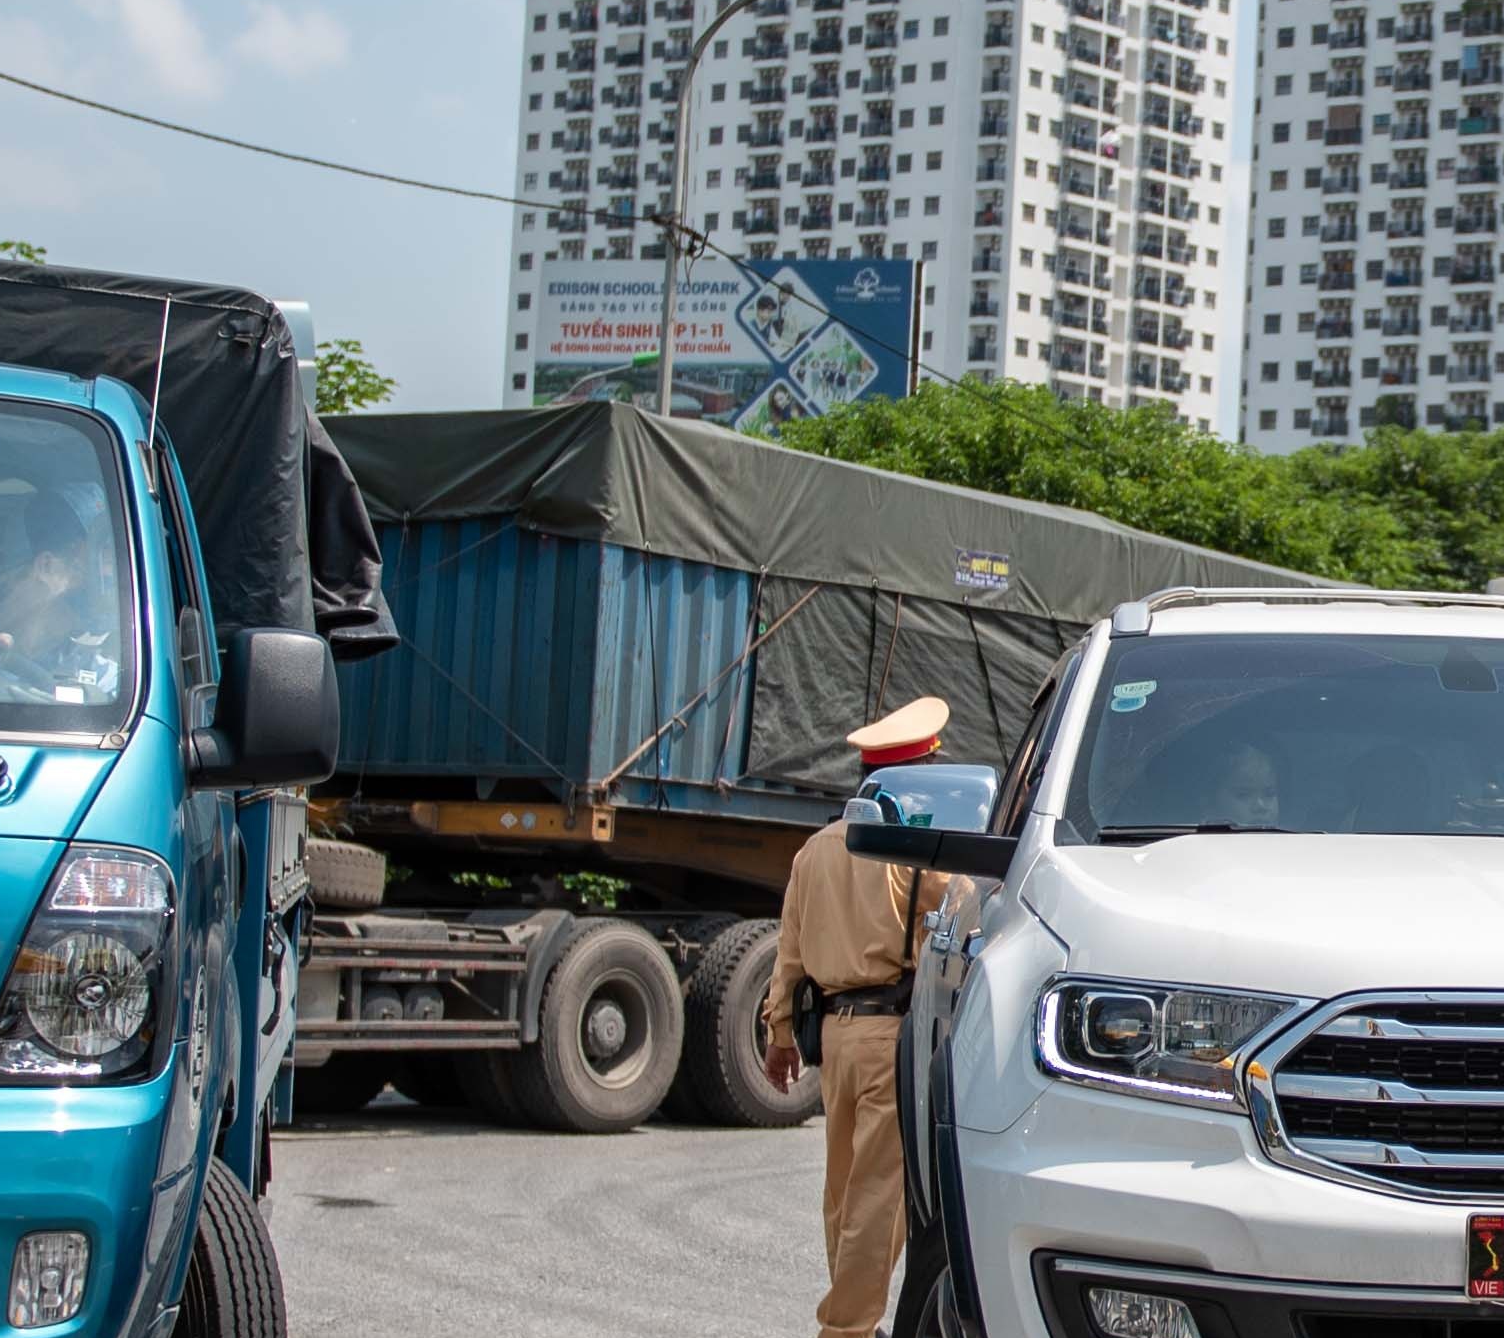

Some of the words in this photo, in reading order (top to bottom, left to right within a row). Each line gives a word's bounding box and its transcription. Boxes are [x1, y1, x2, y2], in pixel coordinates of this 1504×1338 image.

[548, 282, 599, 296] EDISON
[560, 317, 612, 338] TUYỂN
[616, 323, 652, 338] SINH
[1475, 1281, 1499, 1295] VIE
